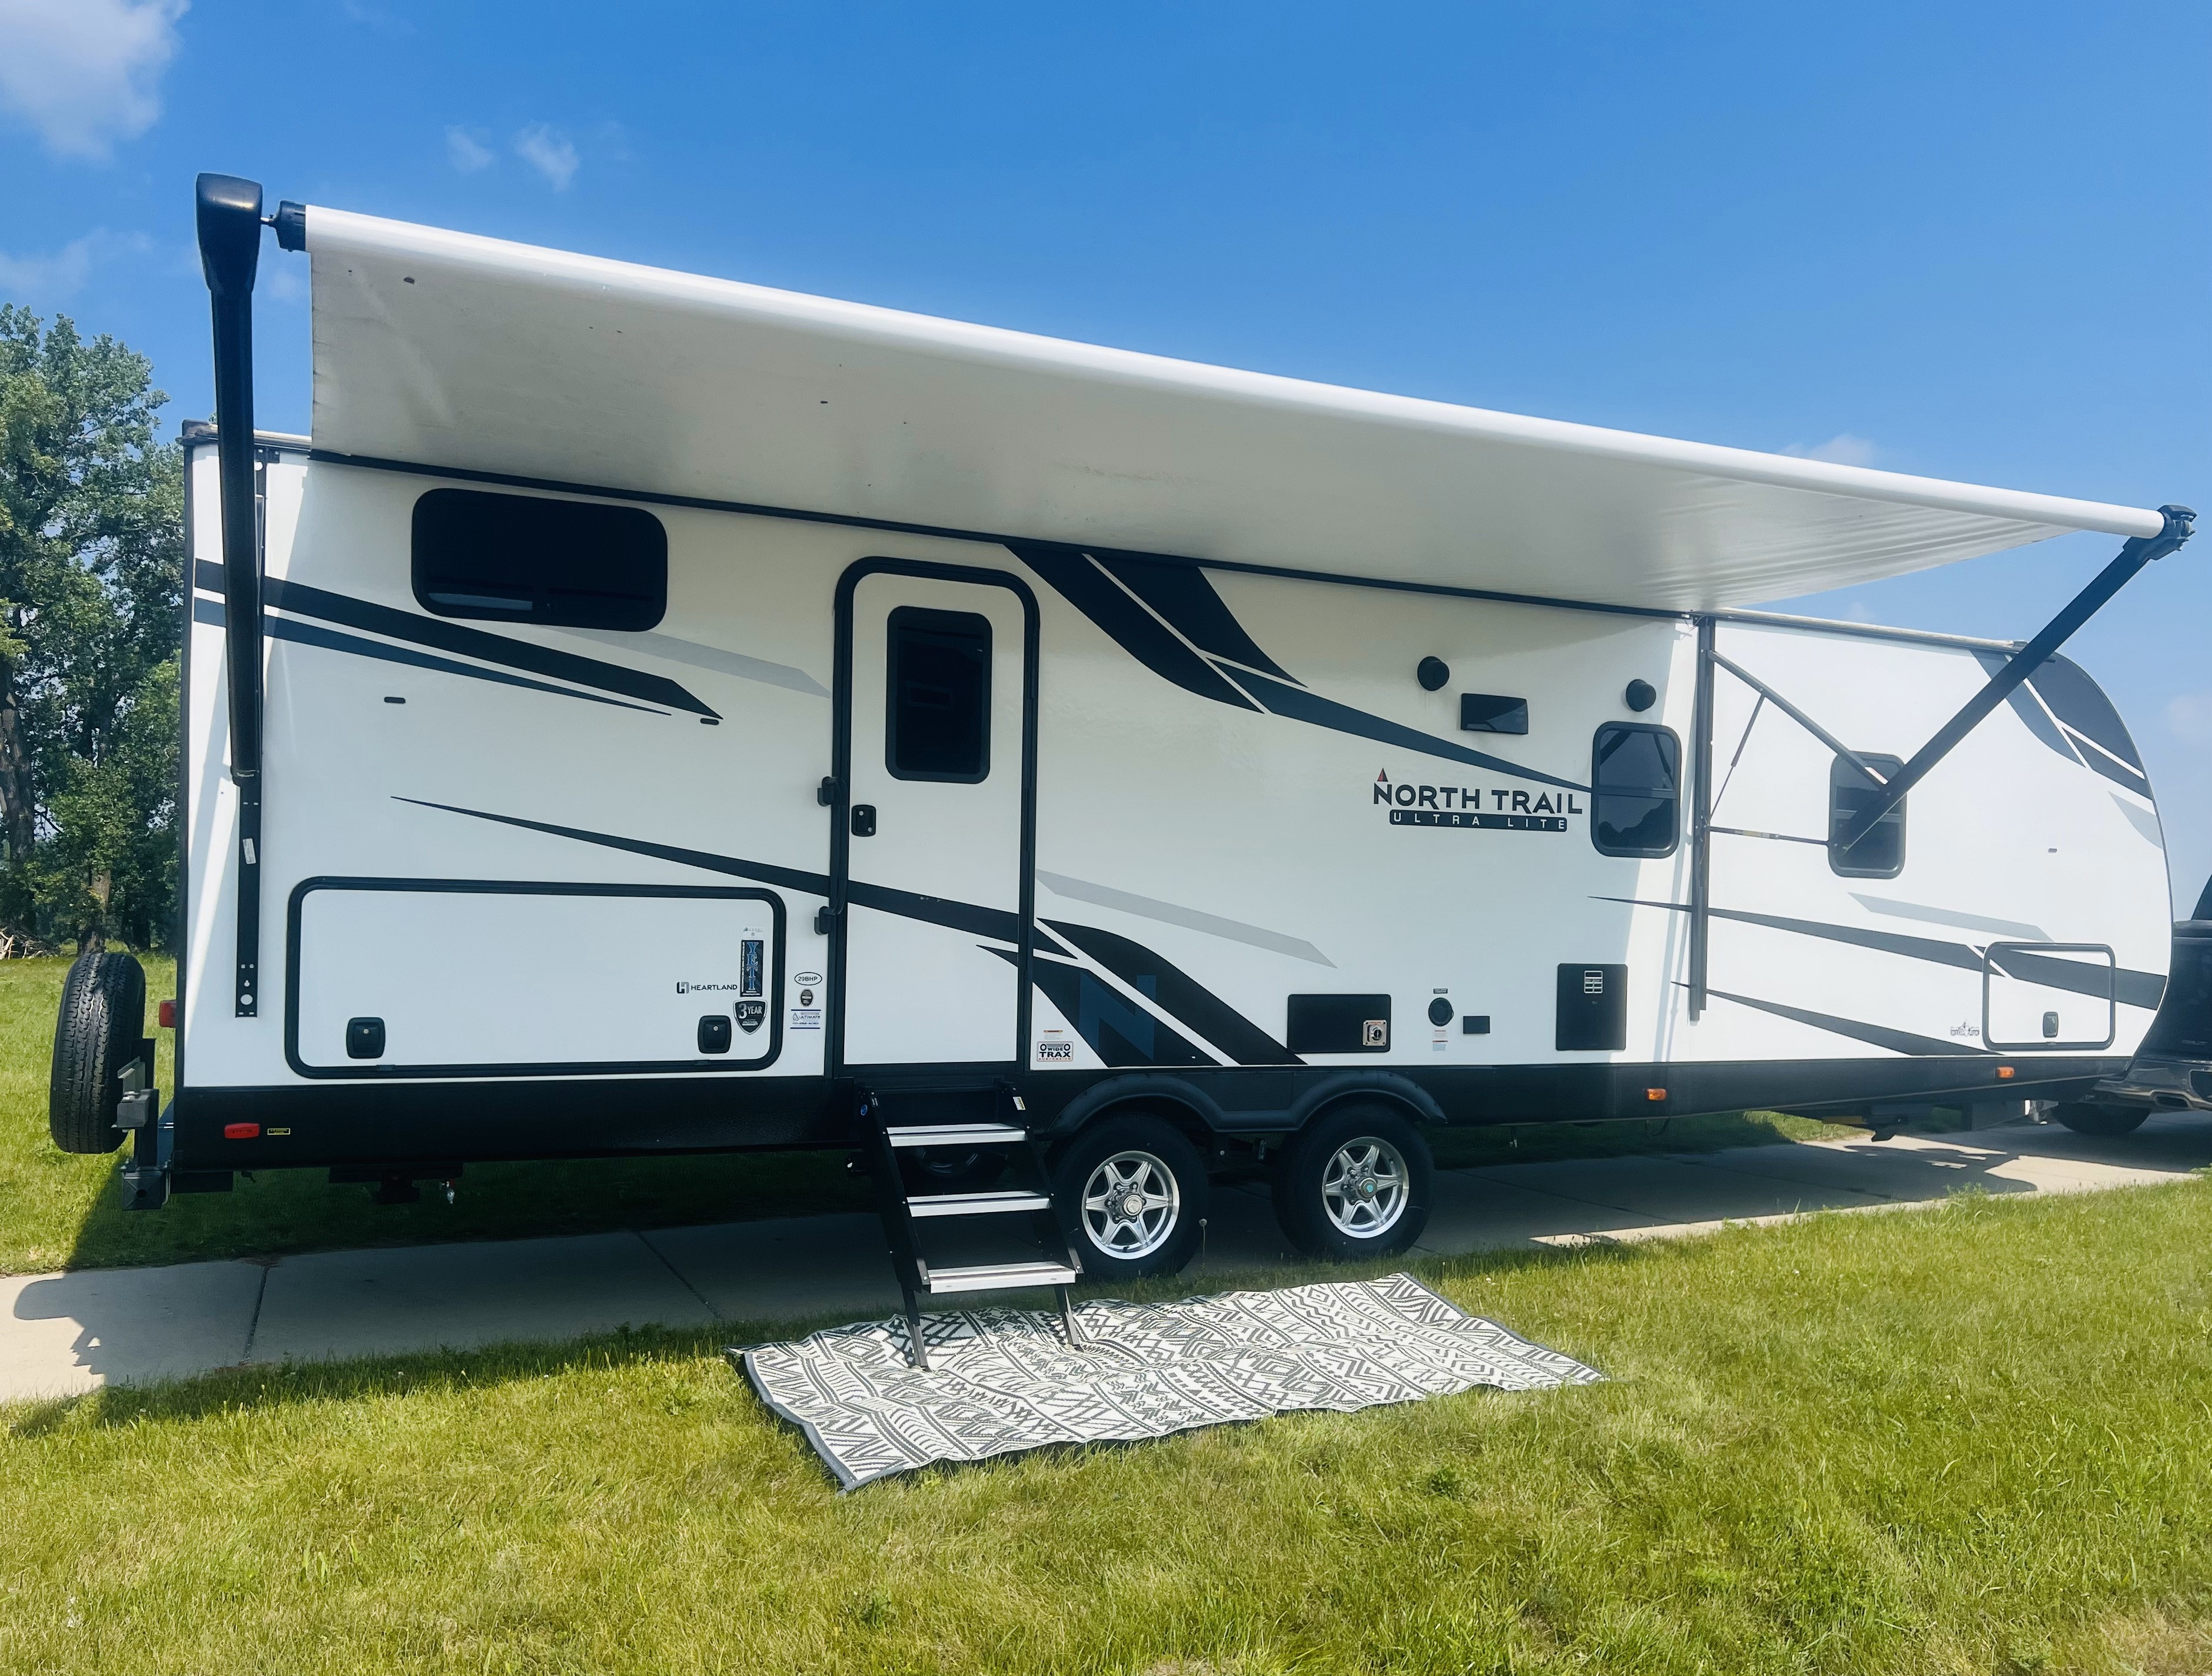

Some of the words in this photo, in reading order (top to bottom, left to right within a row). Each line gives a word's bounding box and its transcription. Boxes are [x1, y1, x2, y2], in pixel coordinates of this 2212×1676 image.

[1373, 782, 1480, 809] NORTH
[1492, 789, 1583, 815] TRAIL
[1394, 812, 1480, 826] ULTRA
[1507, 817, 1565, 829] LITE
[746, 942, 759, 990] YETI
[738, 1003, 748, 1018] 3
[748, 1005, 762, 1014] YEAR
